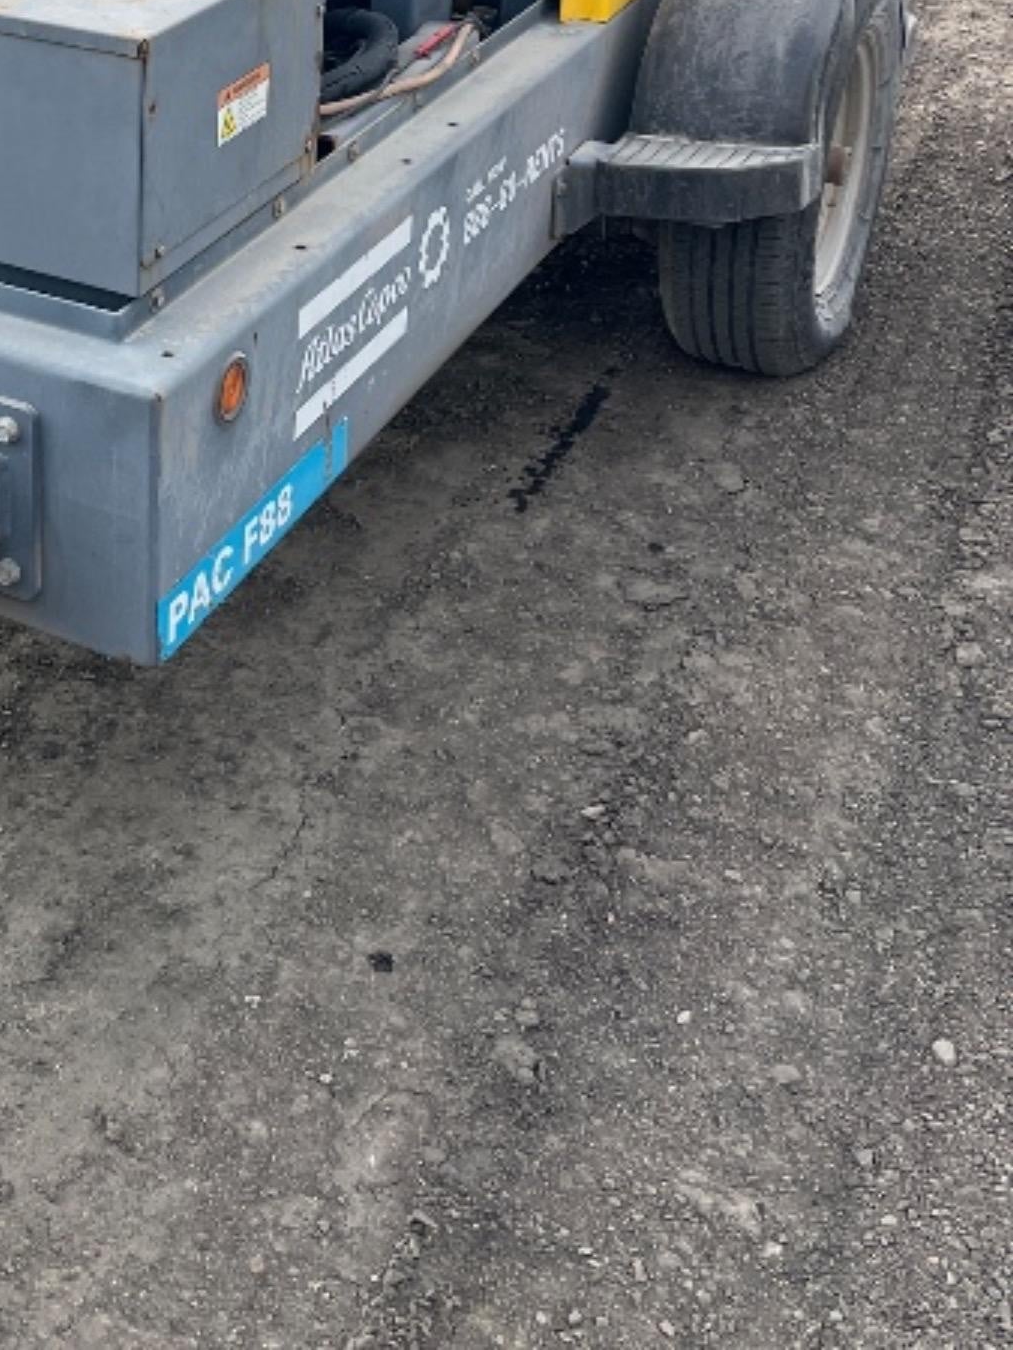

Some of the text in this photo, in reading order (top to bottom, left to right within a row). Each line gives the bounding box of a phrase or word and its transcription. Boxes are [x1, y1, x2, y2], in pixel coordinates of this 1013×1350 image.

[295, 265, 412, 395] Atlas Copco
[169, 484, 294, 644] PAC F88
